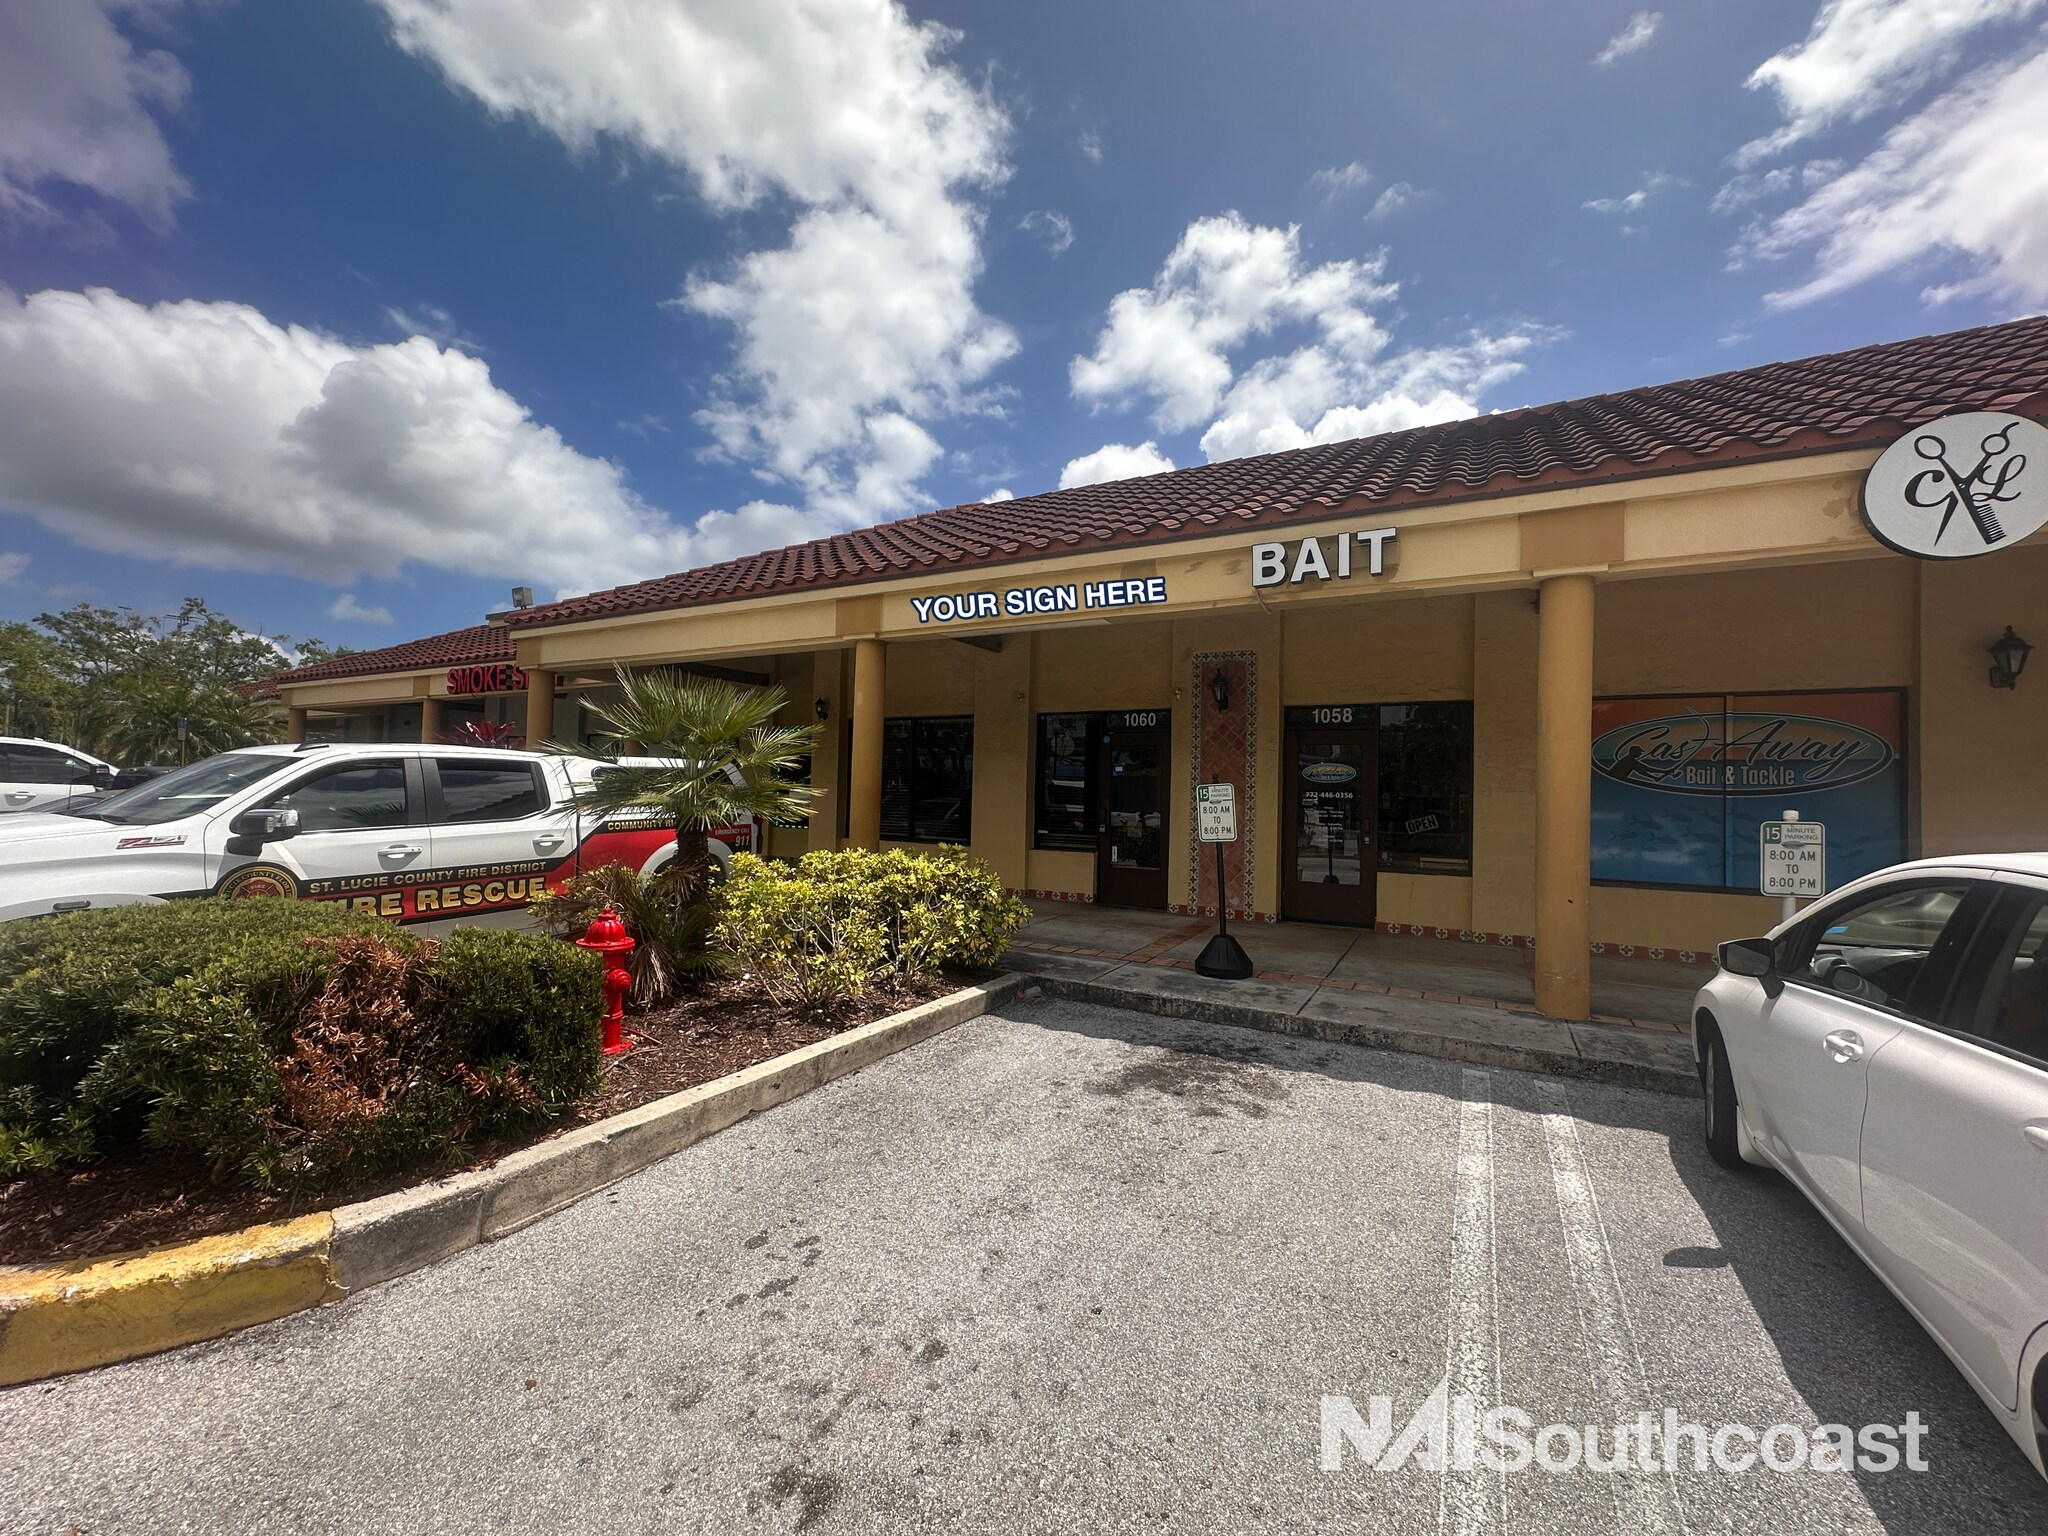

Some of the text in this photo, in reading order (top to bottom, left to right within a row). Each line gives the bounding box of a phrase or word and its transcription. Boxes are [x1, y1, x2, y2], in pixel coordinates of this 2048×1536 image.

[1252, 527, 1397, 588] BAIT
[447, 663, 510, 694] SMOKE
[1124, 712, 1156, 727] 1060
[1312, 708, 1353, 723] 1058
[1615, 719, 1870, 781] Cast Away
[1686, 765, 1795, 785] Bait & Tackle
[1200, 788, 1209, 799] 15
[1220, 805, 1231, 814] AM
[607, 819, 662, 831] COMMUNITY
[1212, 816, 1221, 824] TO
[1407, 815, 1438, 833] OPEN
[1221, 827, 1232, 835] PM
[1765, 827, 1780, 840] 15
[735, 835, 750, 847] 911
[1769, 849, 1816, 862] 8:00 AM
[241, 871, 275, 880] COUNTY
[1785, 863, 1799, 875] TO
[309, 861, 547, 893] ST. LUCIE COUNTY FIRE DISTRICT
[1769, 876, 1816, 889] 8:00 PM
[337, 877, 545, 918] IRE RESCUE
